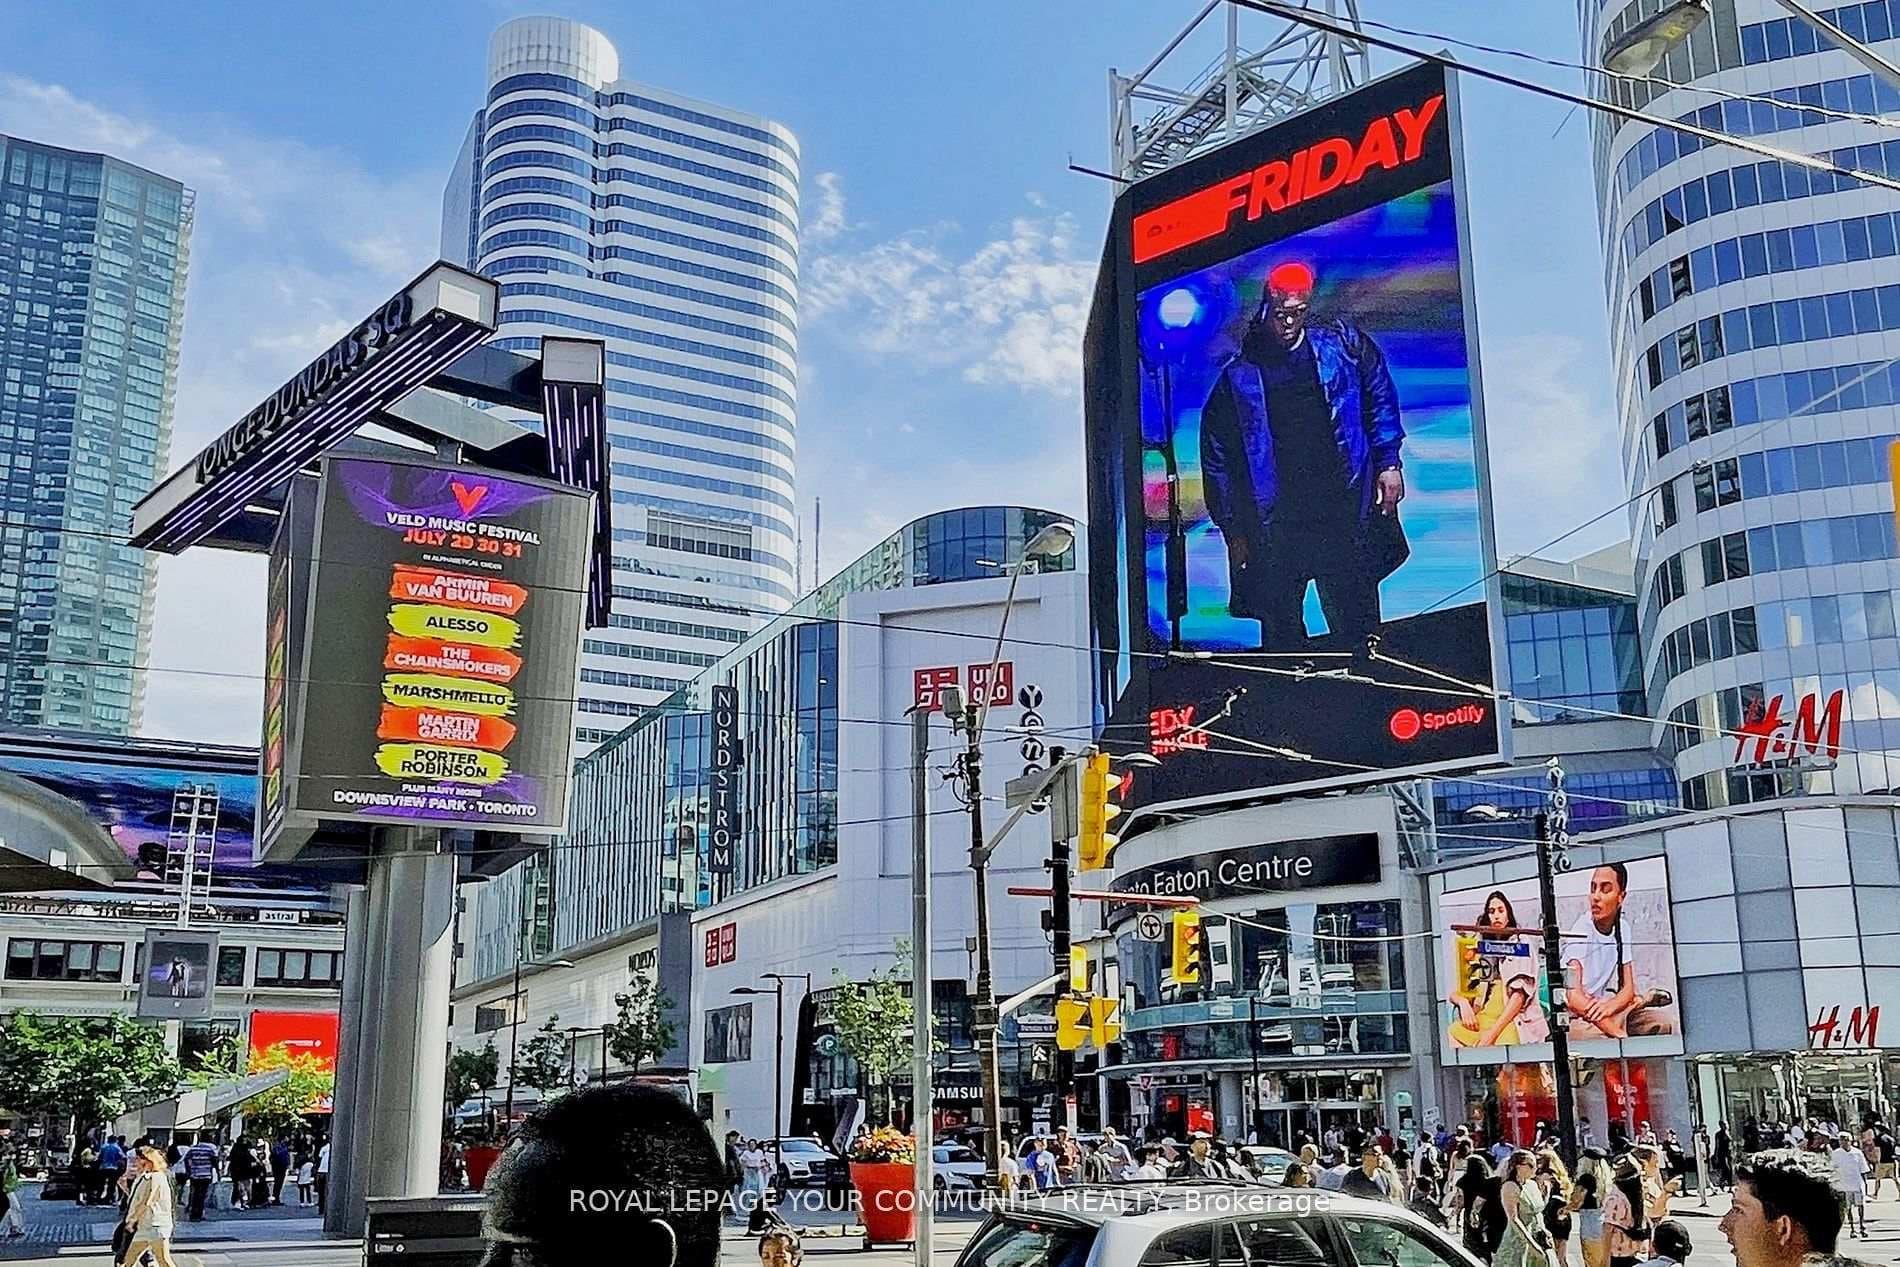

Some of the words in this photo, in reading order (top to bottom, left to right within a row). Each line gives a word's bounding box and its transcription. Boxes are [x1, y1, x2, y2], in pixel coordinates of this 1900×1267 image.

[1217, 95, 1444, 233] FRIDAY
[386, 512, 426, 527] VELD
[428, 517, 477, 535] MUSIC
[478, 524, 541, 545] FESTIVAL
[403, 529, 447, 546] JULY
[450, 534, 474, 550] 29
[477, 539, 499, 553] 30
[502, 542, 523, 558] 31
[406, 583, 444, 599] VAN
[445, 588, 513, 608] BUUREN
[434, 575, 490, 592] ARMIN
[426, 616, 489, 633] ALESSO
[394, 653, 512, 677] CHAINSMOKERS
[441, 646, 471, 660] THE
[393, 684, 506, 706] MARSHMELLO
[417, 713, 480, 732] MARTIN
[1423, 703, 1485, 730] Spotify
[1735, 689, 1843, 767] H&M
[418, 726, 478, 742] GARRIX
[414, 749, 478, 765] PORTER
[401, 761, 488, 778] ROBINSON
[713, 691, 732, 867] NORDSTROM
[333, 790, 427, 809] DOWNSVIEW
[428, 797, 467, 812] PARK
[476, 801, 537, 817] TORONTO
[1154, 868, 1210, 896] Eaton
[1218, 854, 1313, 885] Centre
[264, 910, 295, 921] astral
[1808, 1004, 1880, 1050] H&M
[930, 1086, 984, 1099] SAMSU
